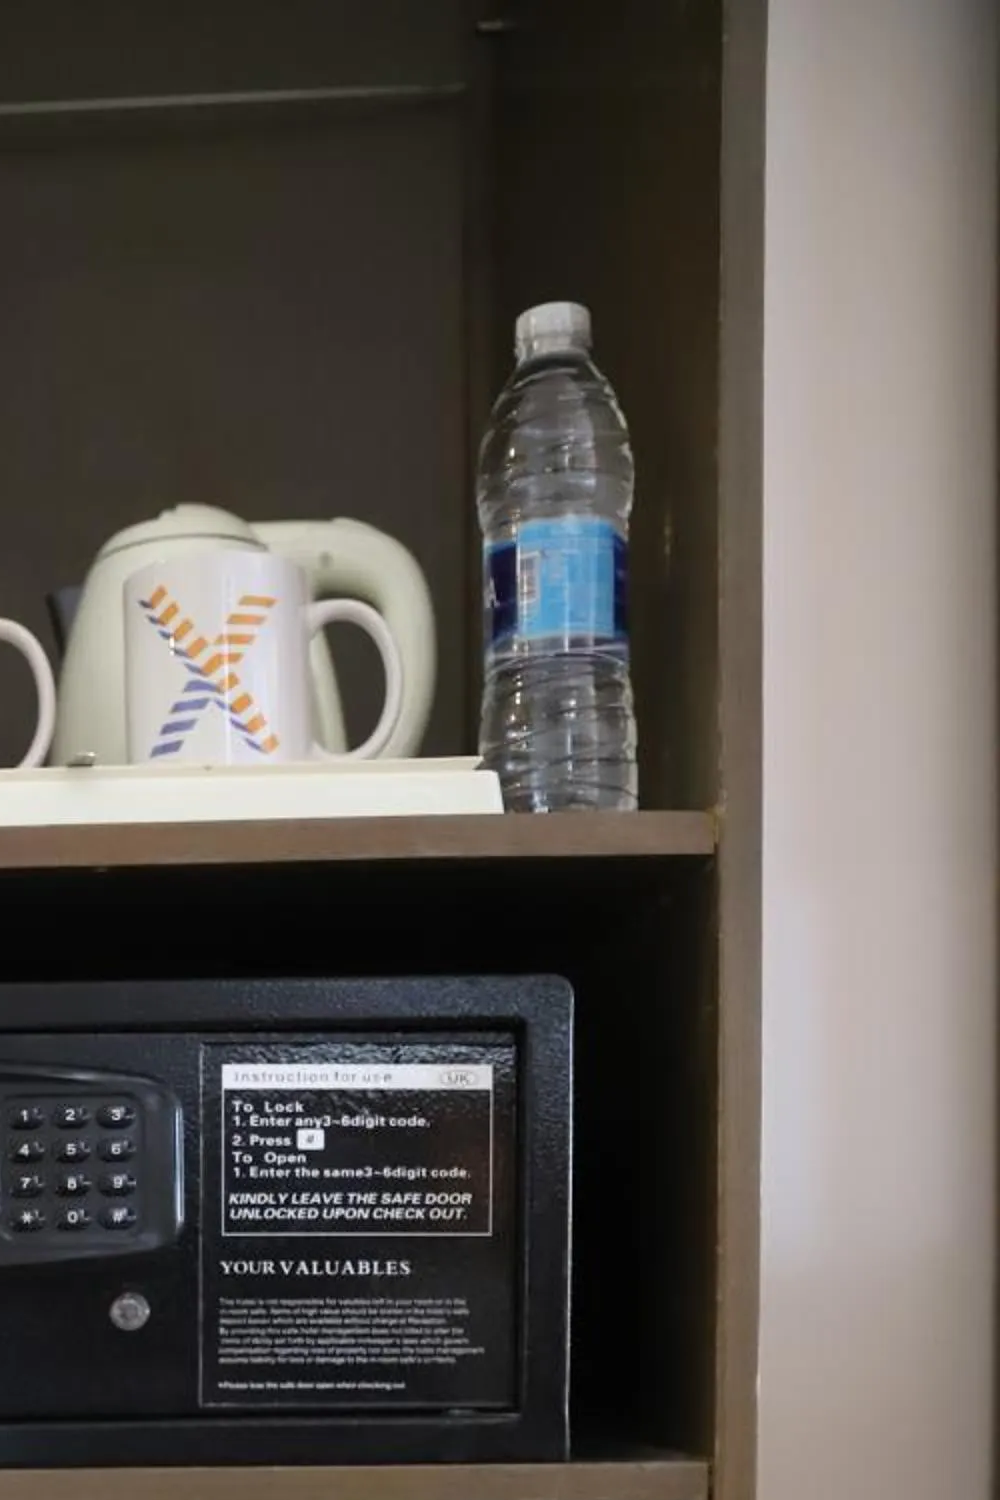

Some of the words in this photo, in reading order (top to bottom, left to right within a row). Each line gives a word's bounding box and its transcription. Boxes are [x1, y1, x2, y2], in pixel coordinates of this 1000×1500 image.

[232, 1100, 254, 1113] To
[263, 1100, 305, 1113] Lock
[20, 1109, 29, 1122] 1
[65, 1108, 76, 1121] 2
[111, 1108, 121, 1121] 3
[232, 1115, 247, 1127] 1.
[249, 1114, 292, 1127] Enter
[389, 1115, 431, 1128] code.
[232, 1133, 247, 1146] 2.
[249, 1133, 292, 1147] Press
[18, 1143, 30, 1156] 4
[66, 1143, 76, 1155] 5
[111, 1143, 121, 1155] 6
[232, 1151, 253, 1164] To
[263, 1151, 307, 1165] Open
[249, 1166, 292, 1178] Enter
[294, 1166, 321, 1178] the
[430, 1166, 471, 1178] code.
[20, 1176, 32, 1189] 7
[67, 1176, 77, 1190] 8
[112, 1175, 123, 1189] 9
[228, 1192, 289, 1205] KINDLY
[291, 1192, 344, 1205] LEAVE
[346, 1192, 379, 1205] THE
[381, 1192, 422, 1205] SAFE
[424, 1192, 473, 1205] DOOR
[229, 1207, 319, 1220] UNLOCKED
[322, 1207, 371, 1219] UPON
[373, 1207, 425, 1219] CHECK
[429, 1207, 468, 1219] OUT.
[219, 1260, 276, 1275] YOUR
[279, 1260, 412, 1275] VALUABLES
